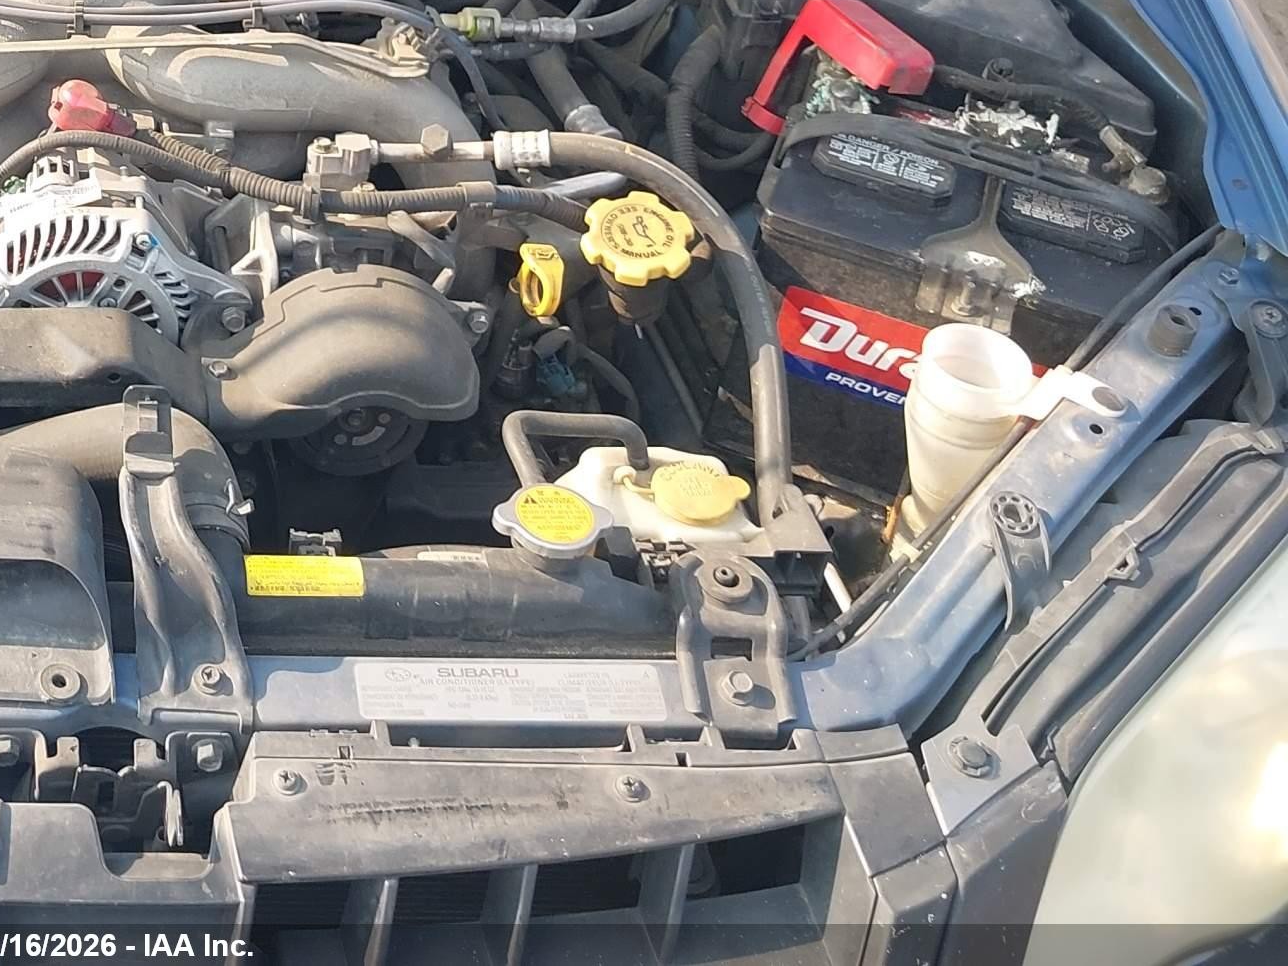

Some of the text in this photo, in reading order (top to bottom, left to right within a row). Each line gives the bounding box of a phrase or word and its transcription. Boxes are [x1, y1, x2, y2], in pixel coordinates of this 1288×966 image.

[848, 134, 890, 151] DANGER
[643, 207, 675, 248] ENGINE OIL
[621, 248, 664, 259] MANUAL
[437, 667, 519, 678] SUBARU
